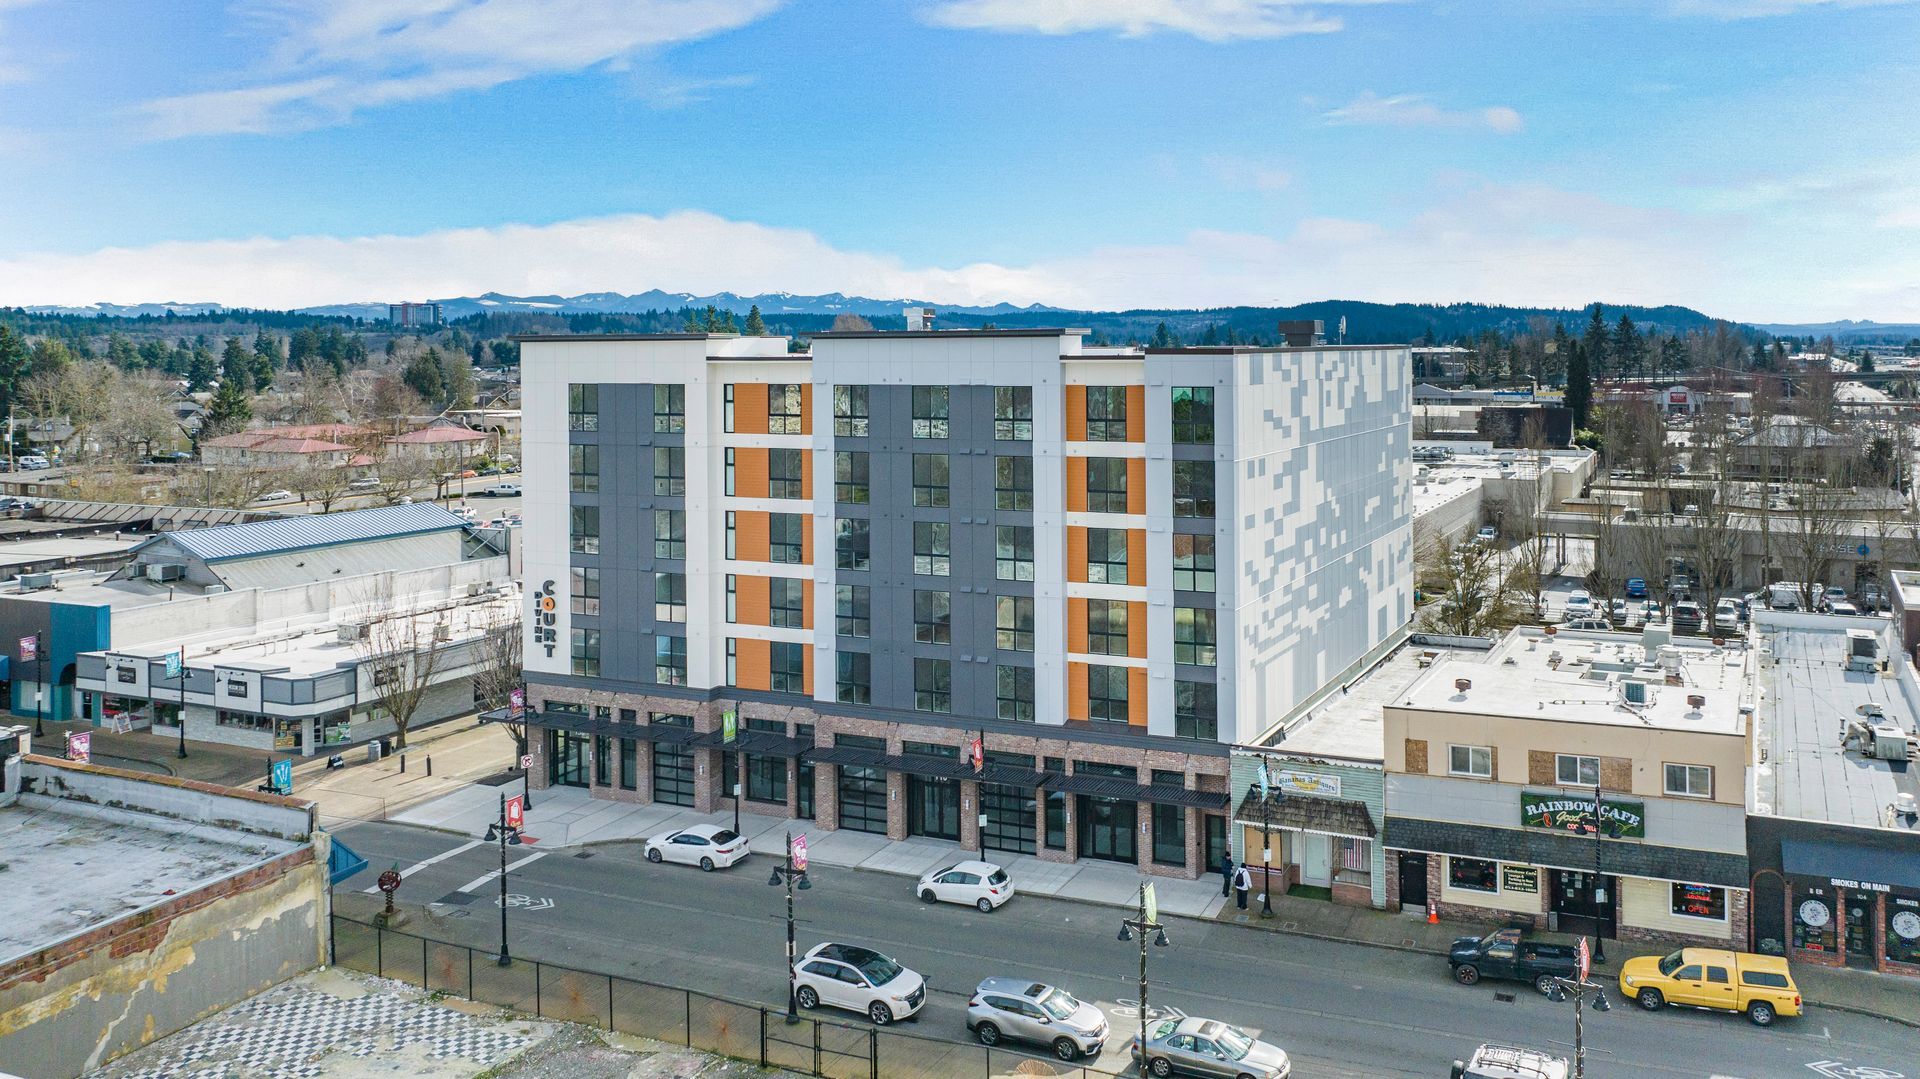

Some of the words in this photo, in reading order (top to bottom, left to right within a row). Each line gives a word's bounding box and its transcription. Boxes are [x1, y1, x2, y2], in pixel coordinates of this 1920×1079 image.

[534, 591, 543, 643] DIVINE
[542, 579, 556, 658] COURT
[1526, 801, 1596, 815] RAINBOW
[1601, 806, 1640, 826] CAFE
[1831, 878, 1858, 888] SMOKES
[1860, 882, 1872, 890] ON
[1872, 884, 1890, 893] MAIN
[1688, 904, 1709, 914] OPEN
[1896, 898, 1918, 907] SMOKES
